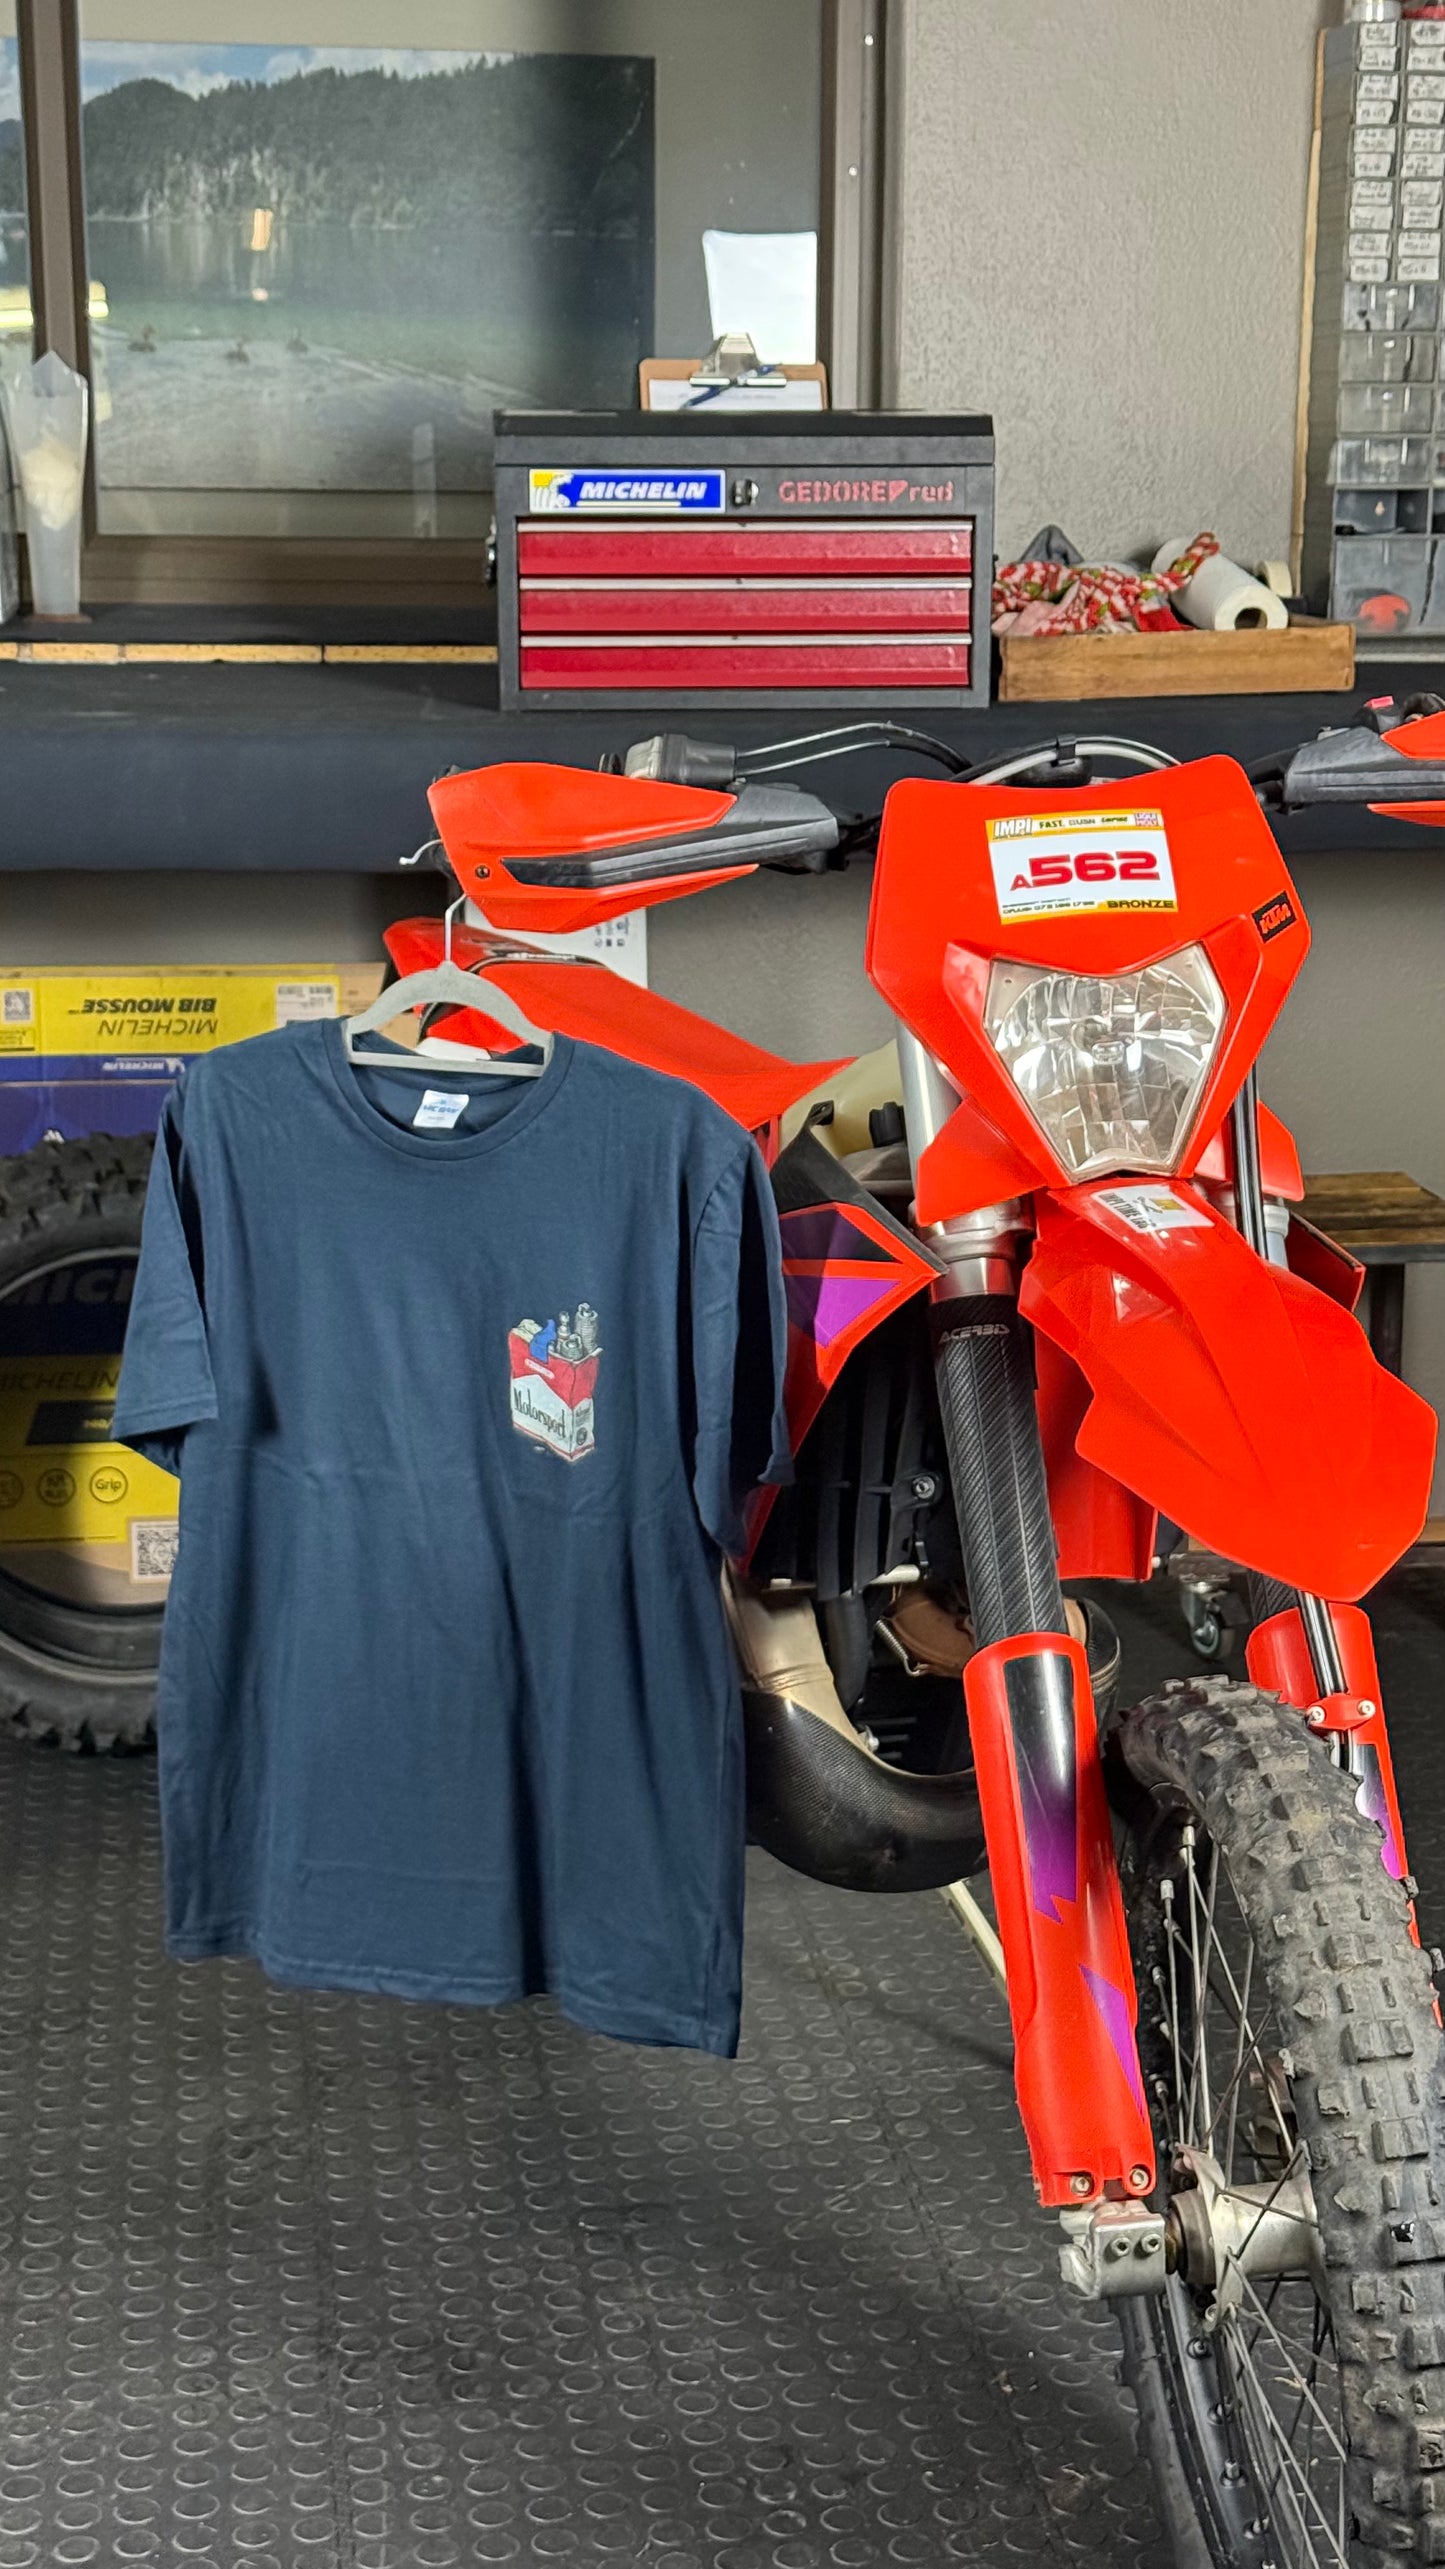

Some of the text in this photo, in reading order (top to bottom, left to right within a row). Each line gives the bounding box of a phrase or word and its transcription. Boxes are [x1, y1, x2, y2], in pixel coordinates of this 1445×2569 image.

[579, 481, 708, 500] MICHELIN
[778, 480, 887, 503] GEDORE
[993, 817, 1033, 838] IMPI
[1106, 900, 1174, 909] BRONZE
[1259, 903, 1292, 934] KTM
[178, 997, 218, 1014] BIB
[98, 1018, 219, 1037] MICHELIN
[939, 1323, 1011, 1343] ACERBIS
[0, 1371, 120, 1391] ICHELIN
[95, 1478, 122, 1492] Grip
